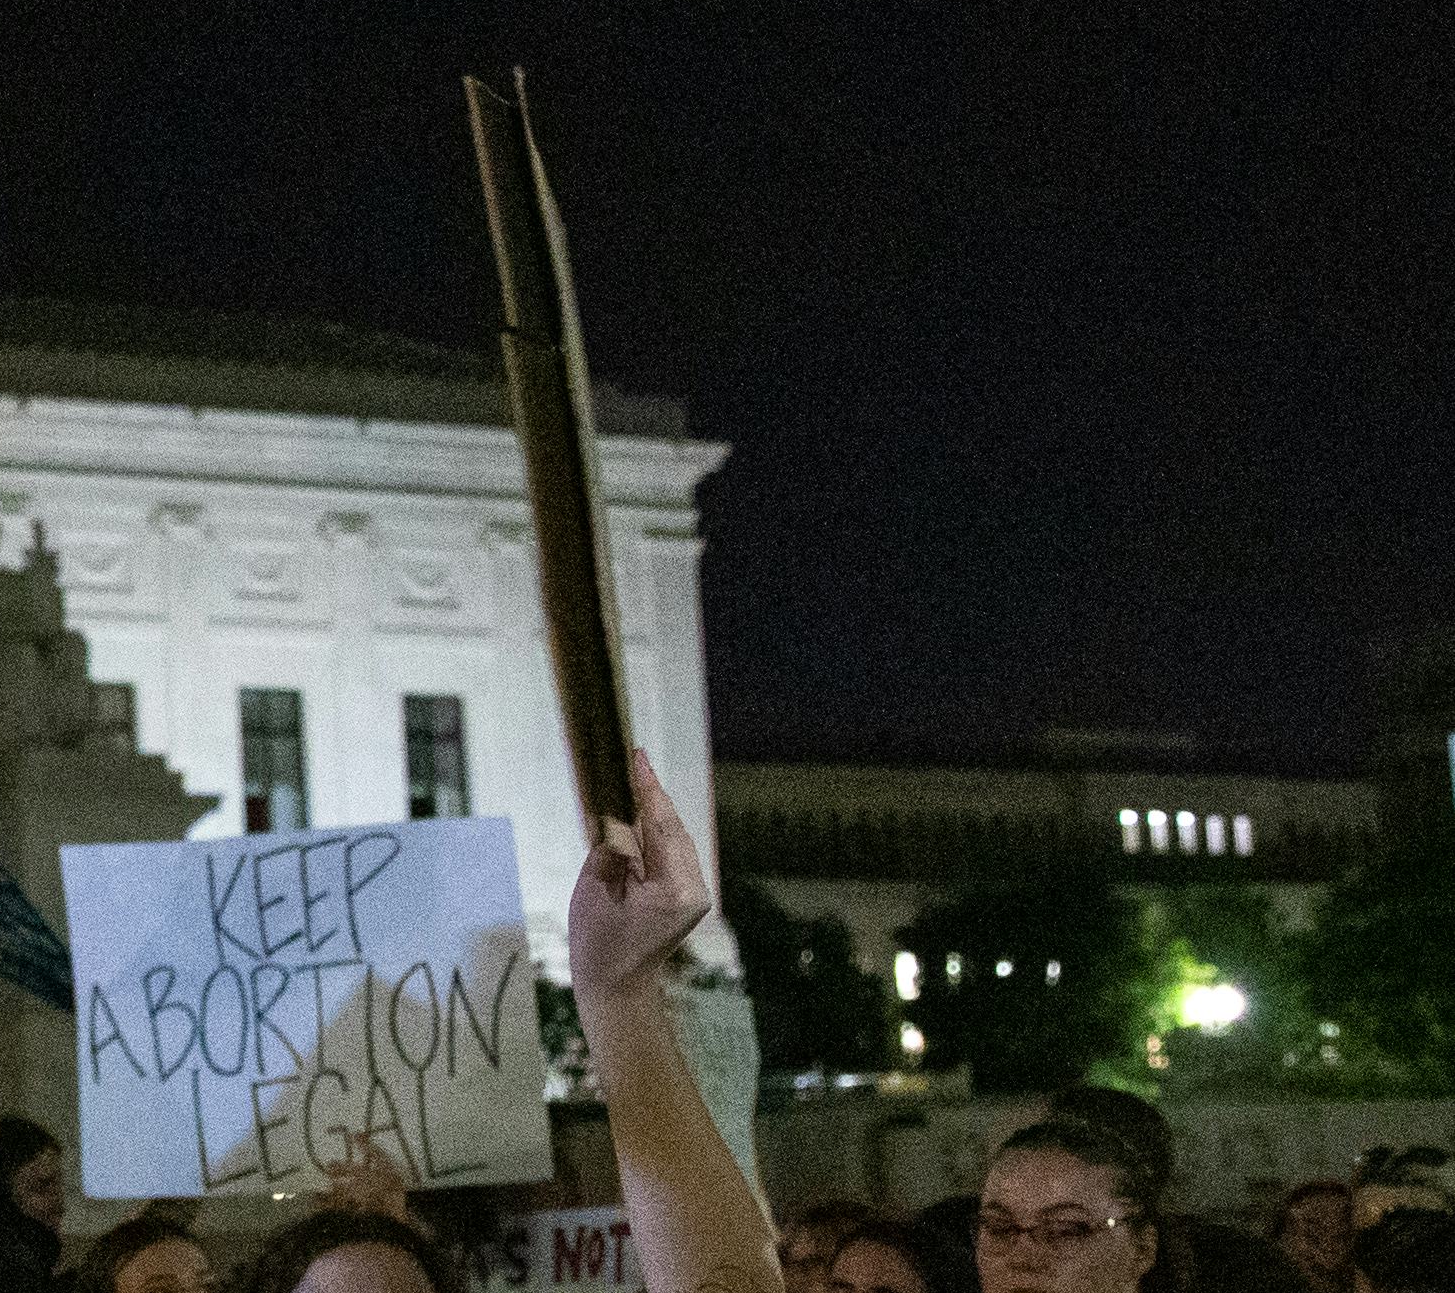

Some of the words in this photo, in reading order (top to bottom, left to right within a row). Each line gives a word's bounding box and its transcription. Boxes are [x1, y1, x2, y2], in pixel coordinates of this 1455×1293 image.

[206, 832, 402, 964] KEEP
[88, 951, 518, 1084] ABORTION
[191, 1069, 487, 1191] LEGAL
[552, 1222, 631, 1284] NOT
